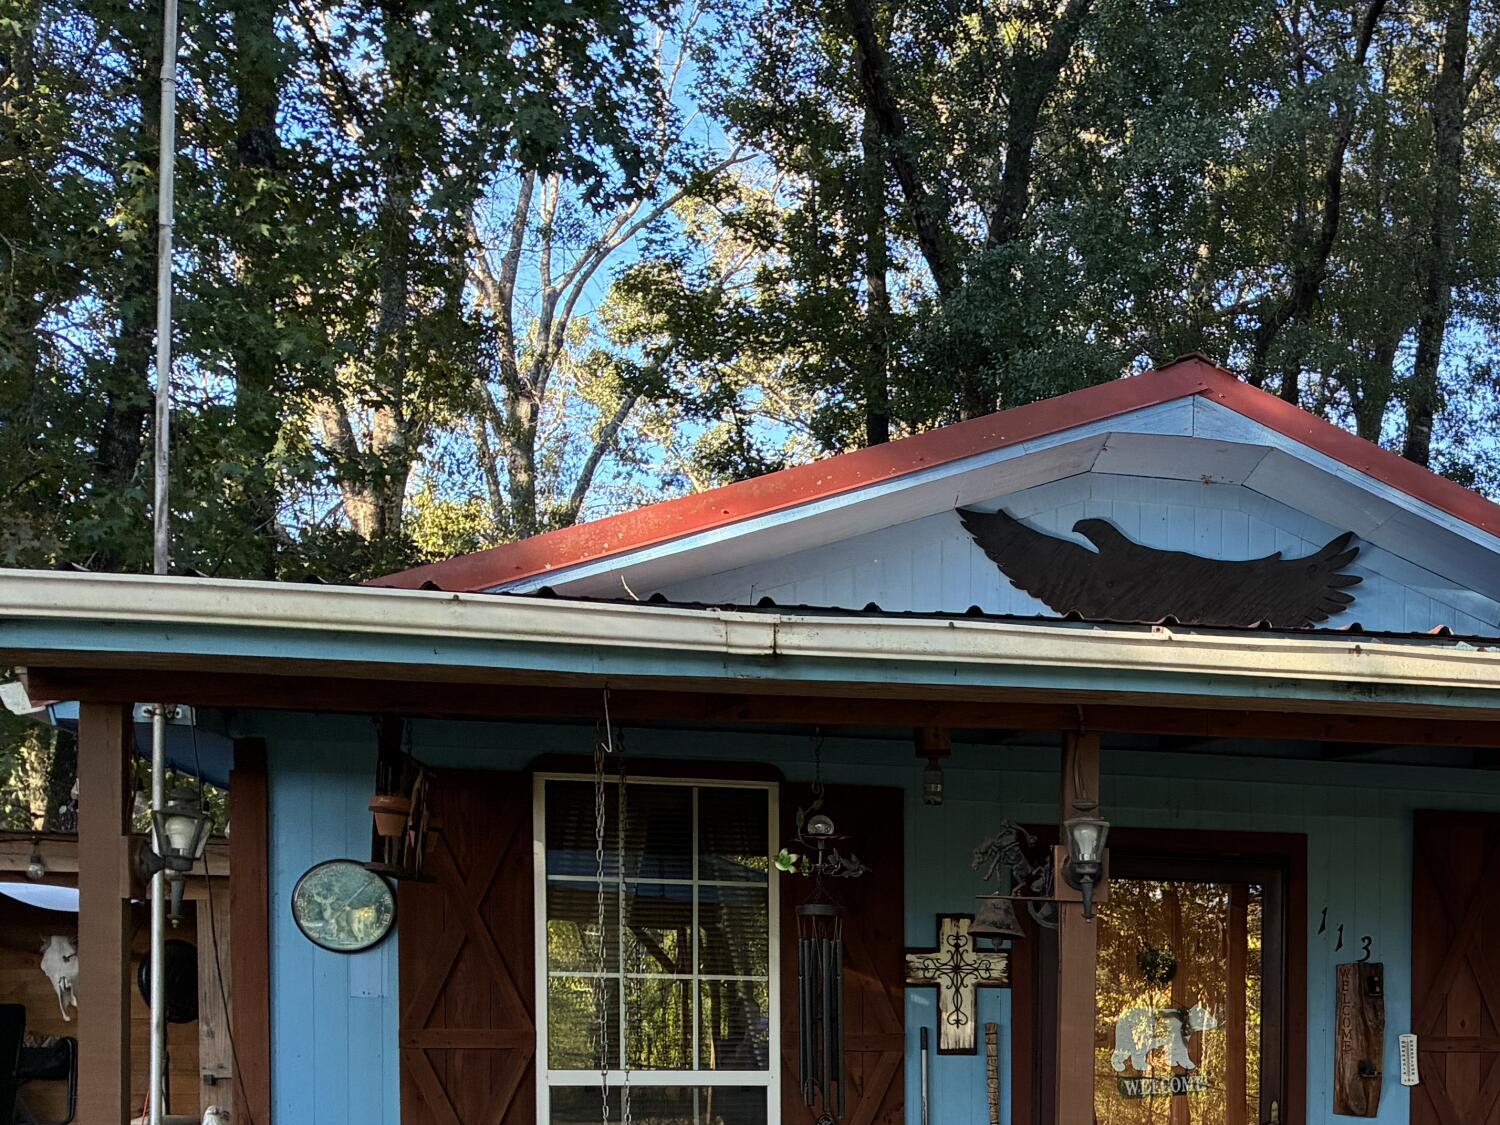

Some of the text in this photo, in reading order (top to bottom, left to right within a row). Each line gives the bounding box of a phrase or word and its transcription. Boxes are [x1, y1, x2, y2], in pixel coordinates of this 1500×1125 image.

[1318, 906, 1373, 963] 113
[1339, 966, 1353, 1054] WELCOME
[1124, 1075, 1208, 1097] WELCOME
